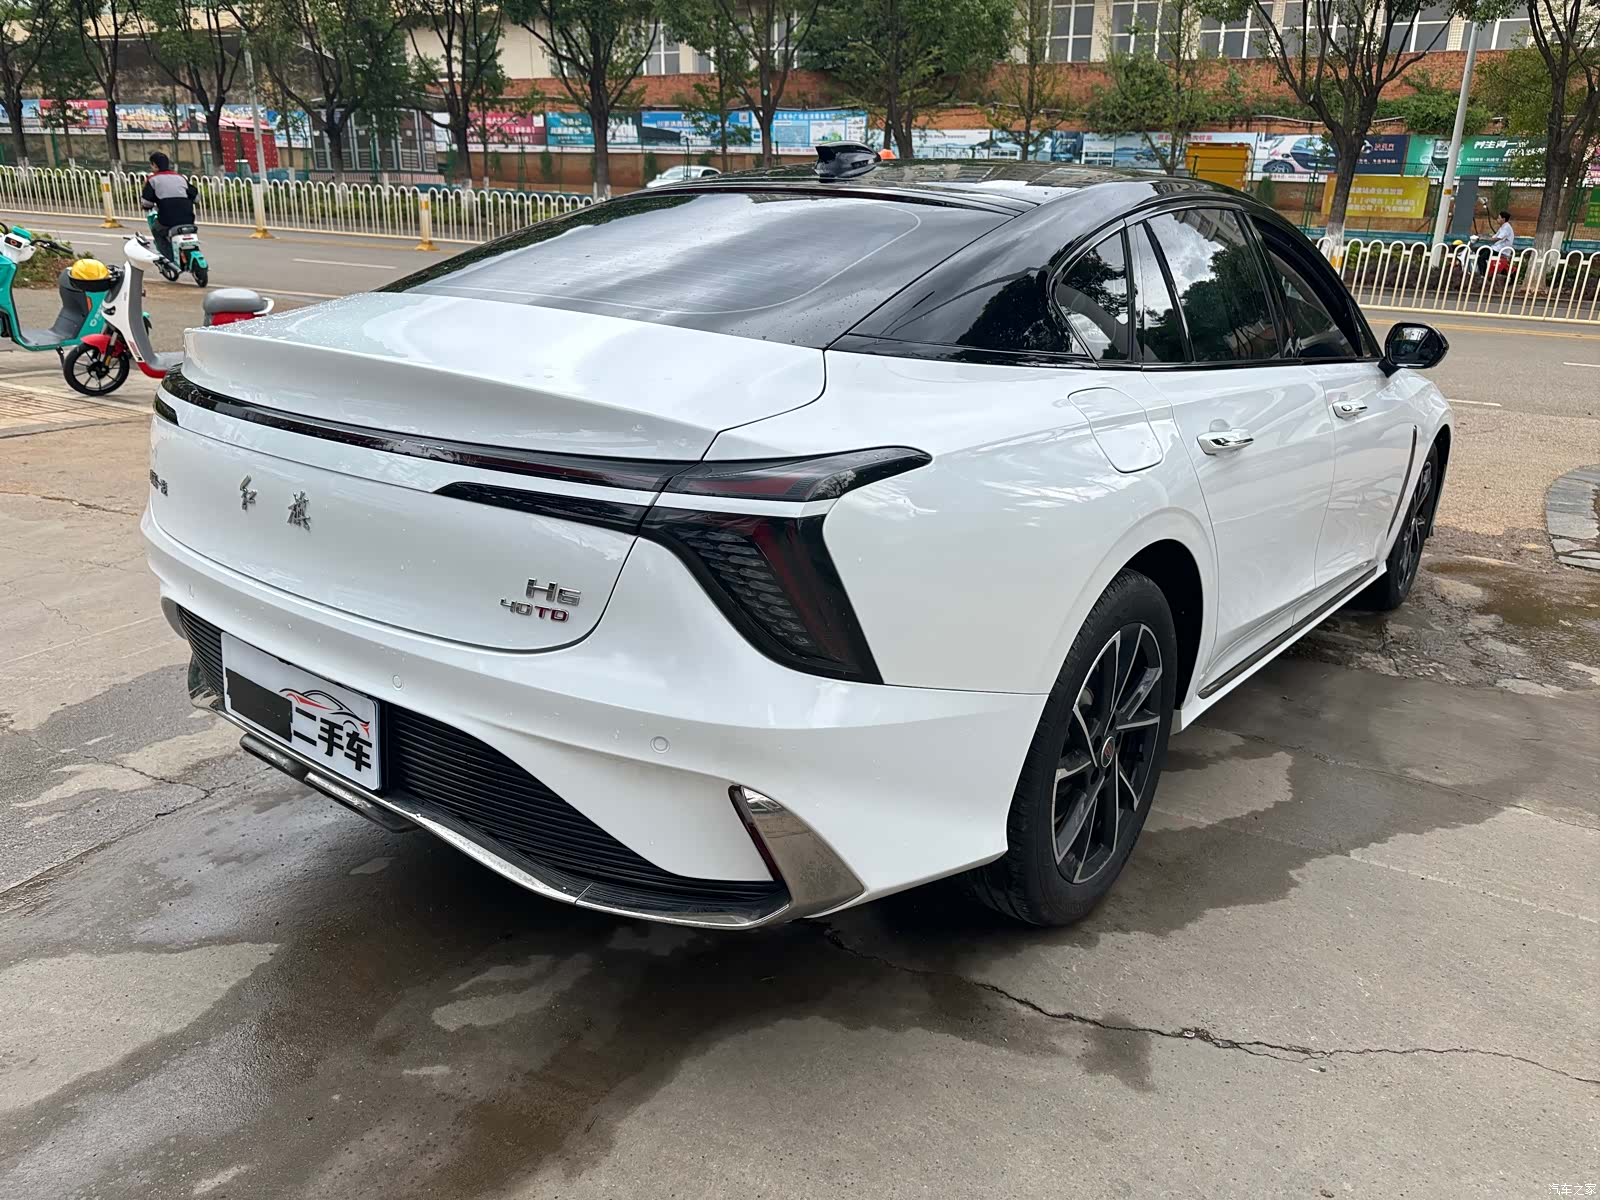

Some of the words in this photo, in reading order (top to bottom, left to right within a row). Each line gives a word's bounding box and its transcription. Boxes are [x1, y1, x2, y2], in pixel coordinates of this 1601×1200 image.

[526, 577, 582, 607] H6
[500, 598, 570, 623] 40TD
[292, 706, 372, 772] 二手车
